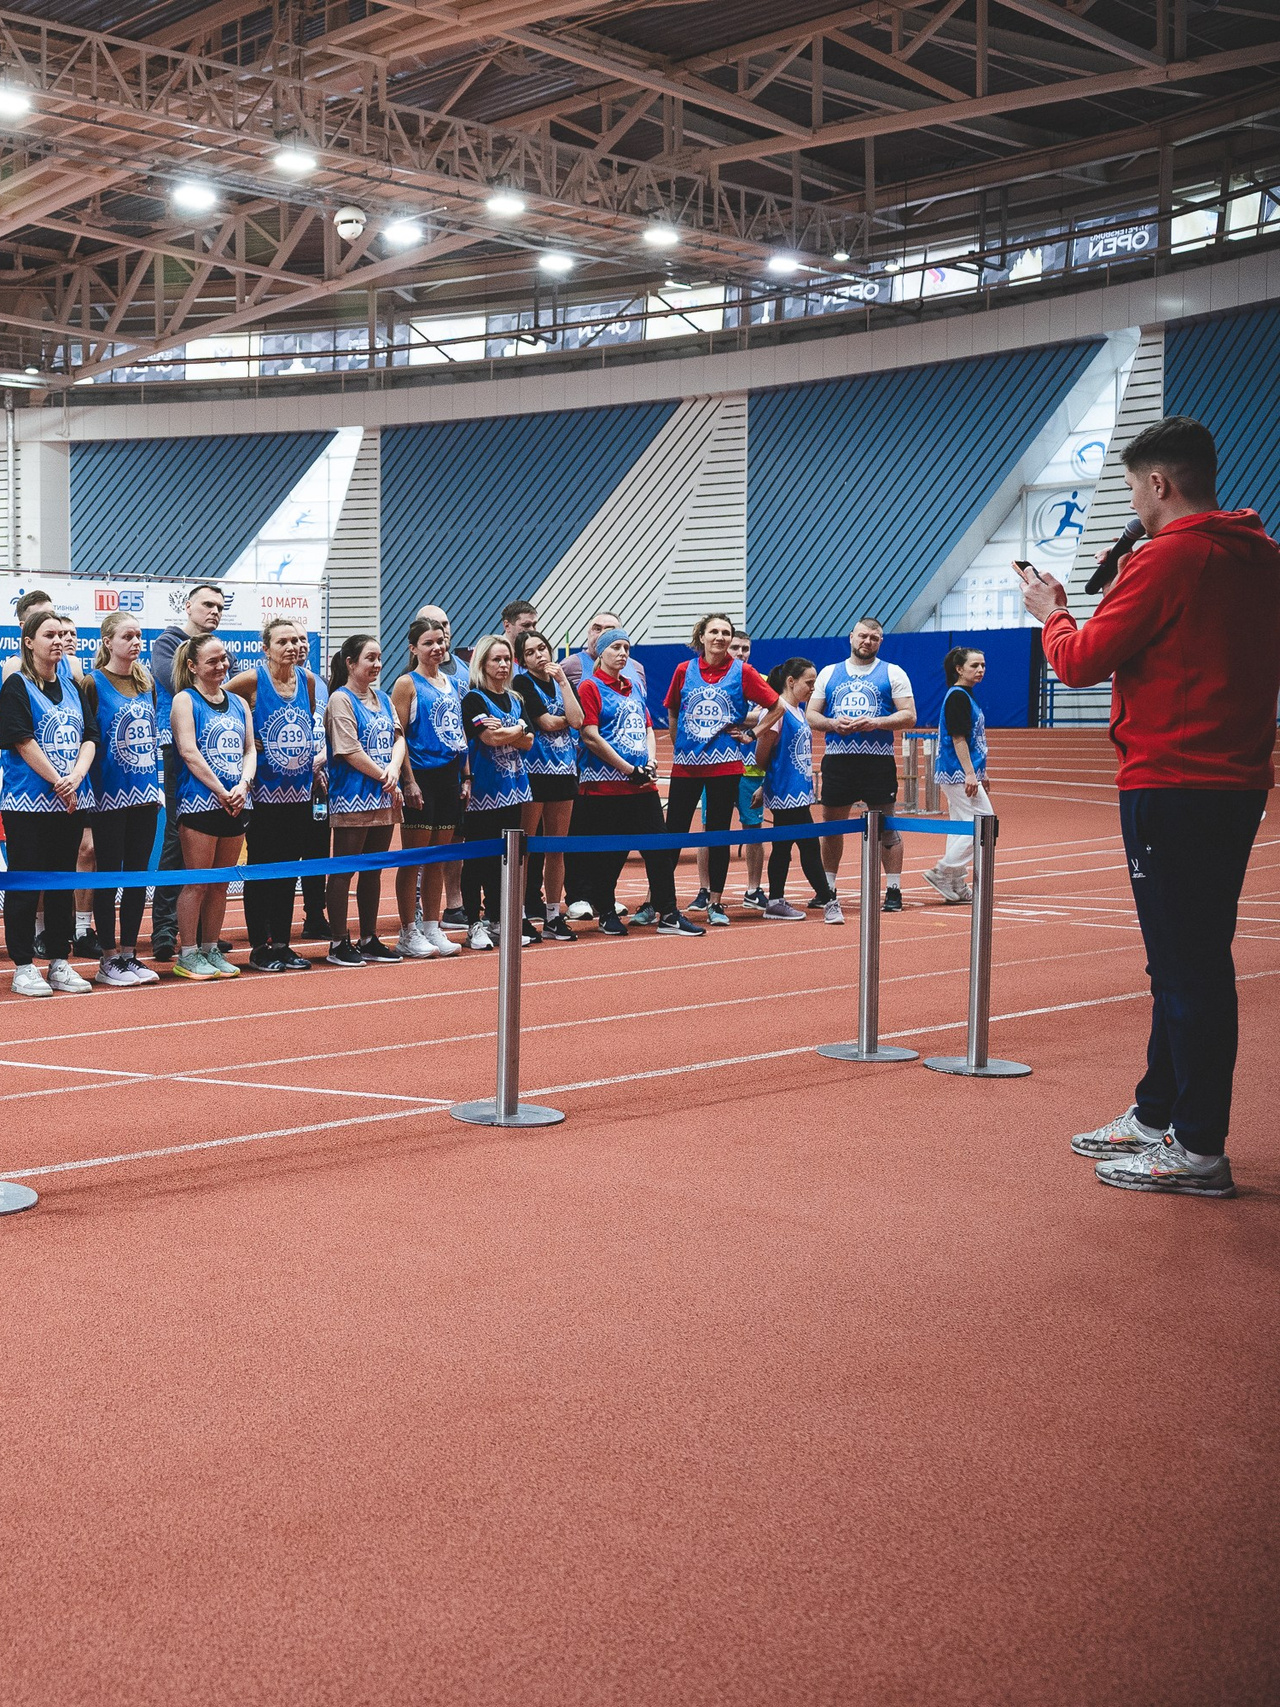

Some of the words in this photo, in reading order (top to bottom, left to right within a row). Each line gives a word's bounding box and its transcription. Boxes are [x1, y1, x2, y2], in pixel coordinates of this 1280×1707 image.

[261, 596, 273, 608] 10
[275, 597, 309, 609] МАРТА
[845, 696, 866, 707] 150
[696, 704, 719, 716] 358
[56, 730, 77, 745] 340
[128, 724, 157, 740] 381
[281, 730, 303, 743] 339
[134, 743, 153, 753] ГТО
[222, 737, 241, 749] 288
[225, 753, 240, 762] ГТО
